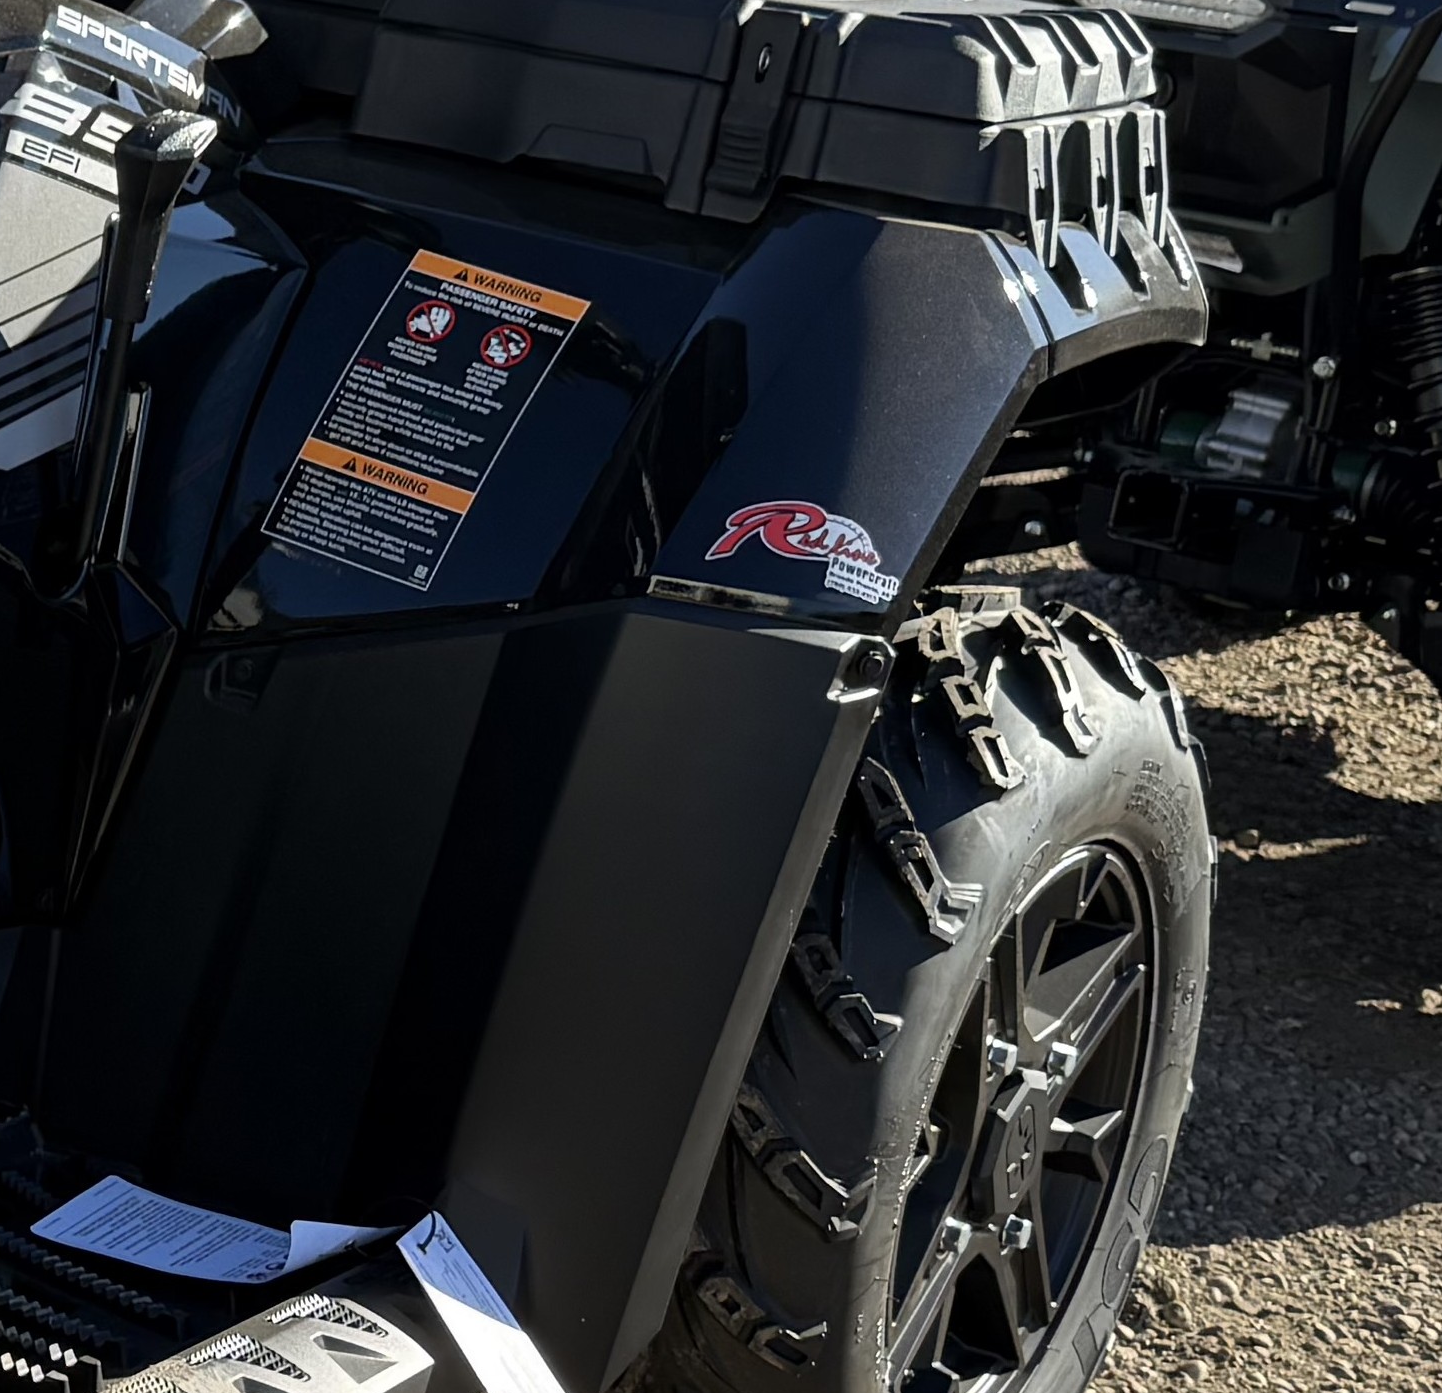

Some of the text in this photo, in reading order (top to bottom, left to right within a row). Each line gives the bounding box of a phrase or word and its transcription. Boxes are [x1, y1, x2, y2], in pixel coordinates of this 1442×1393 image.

[21, 138, 82, 174] EFI
[438, 282, 537, 319] PASSENGER SAFETY
[471, 273, 543, 303] WARNING
[359, 462, 430, 495] WARNING
[831, 557, 897, 591] Powercraft
